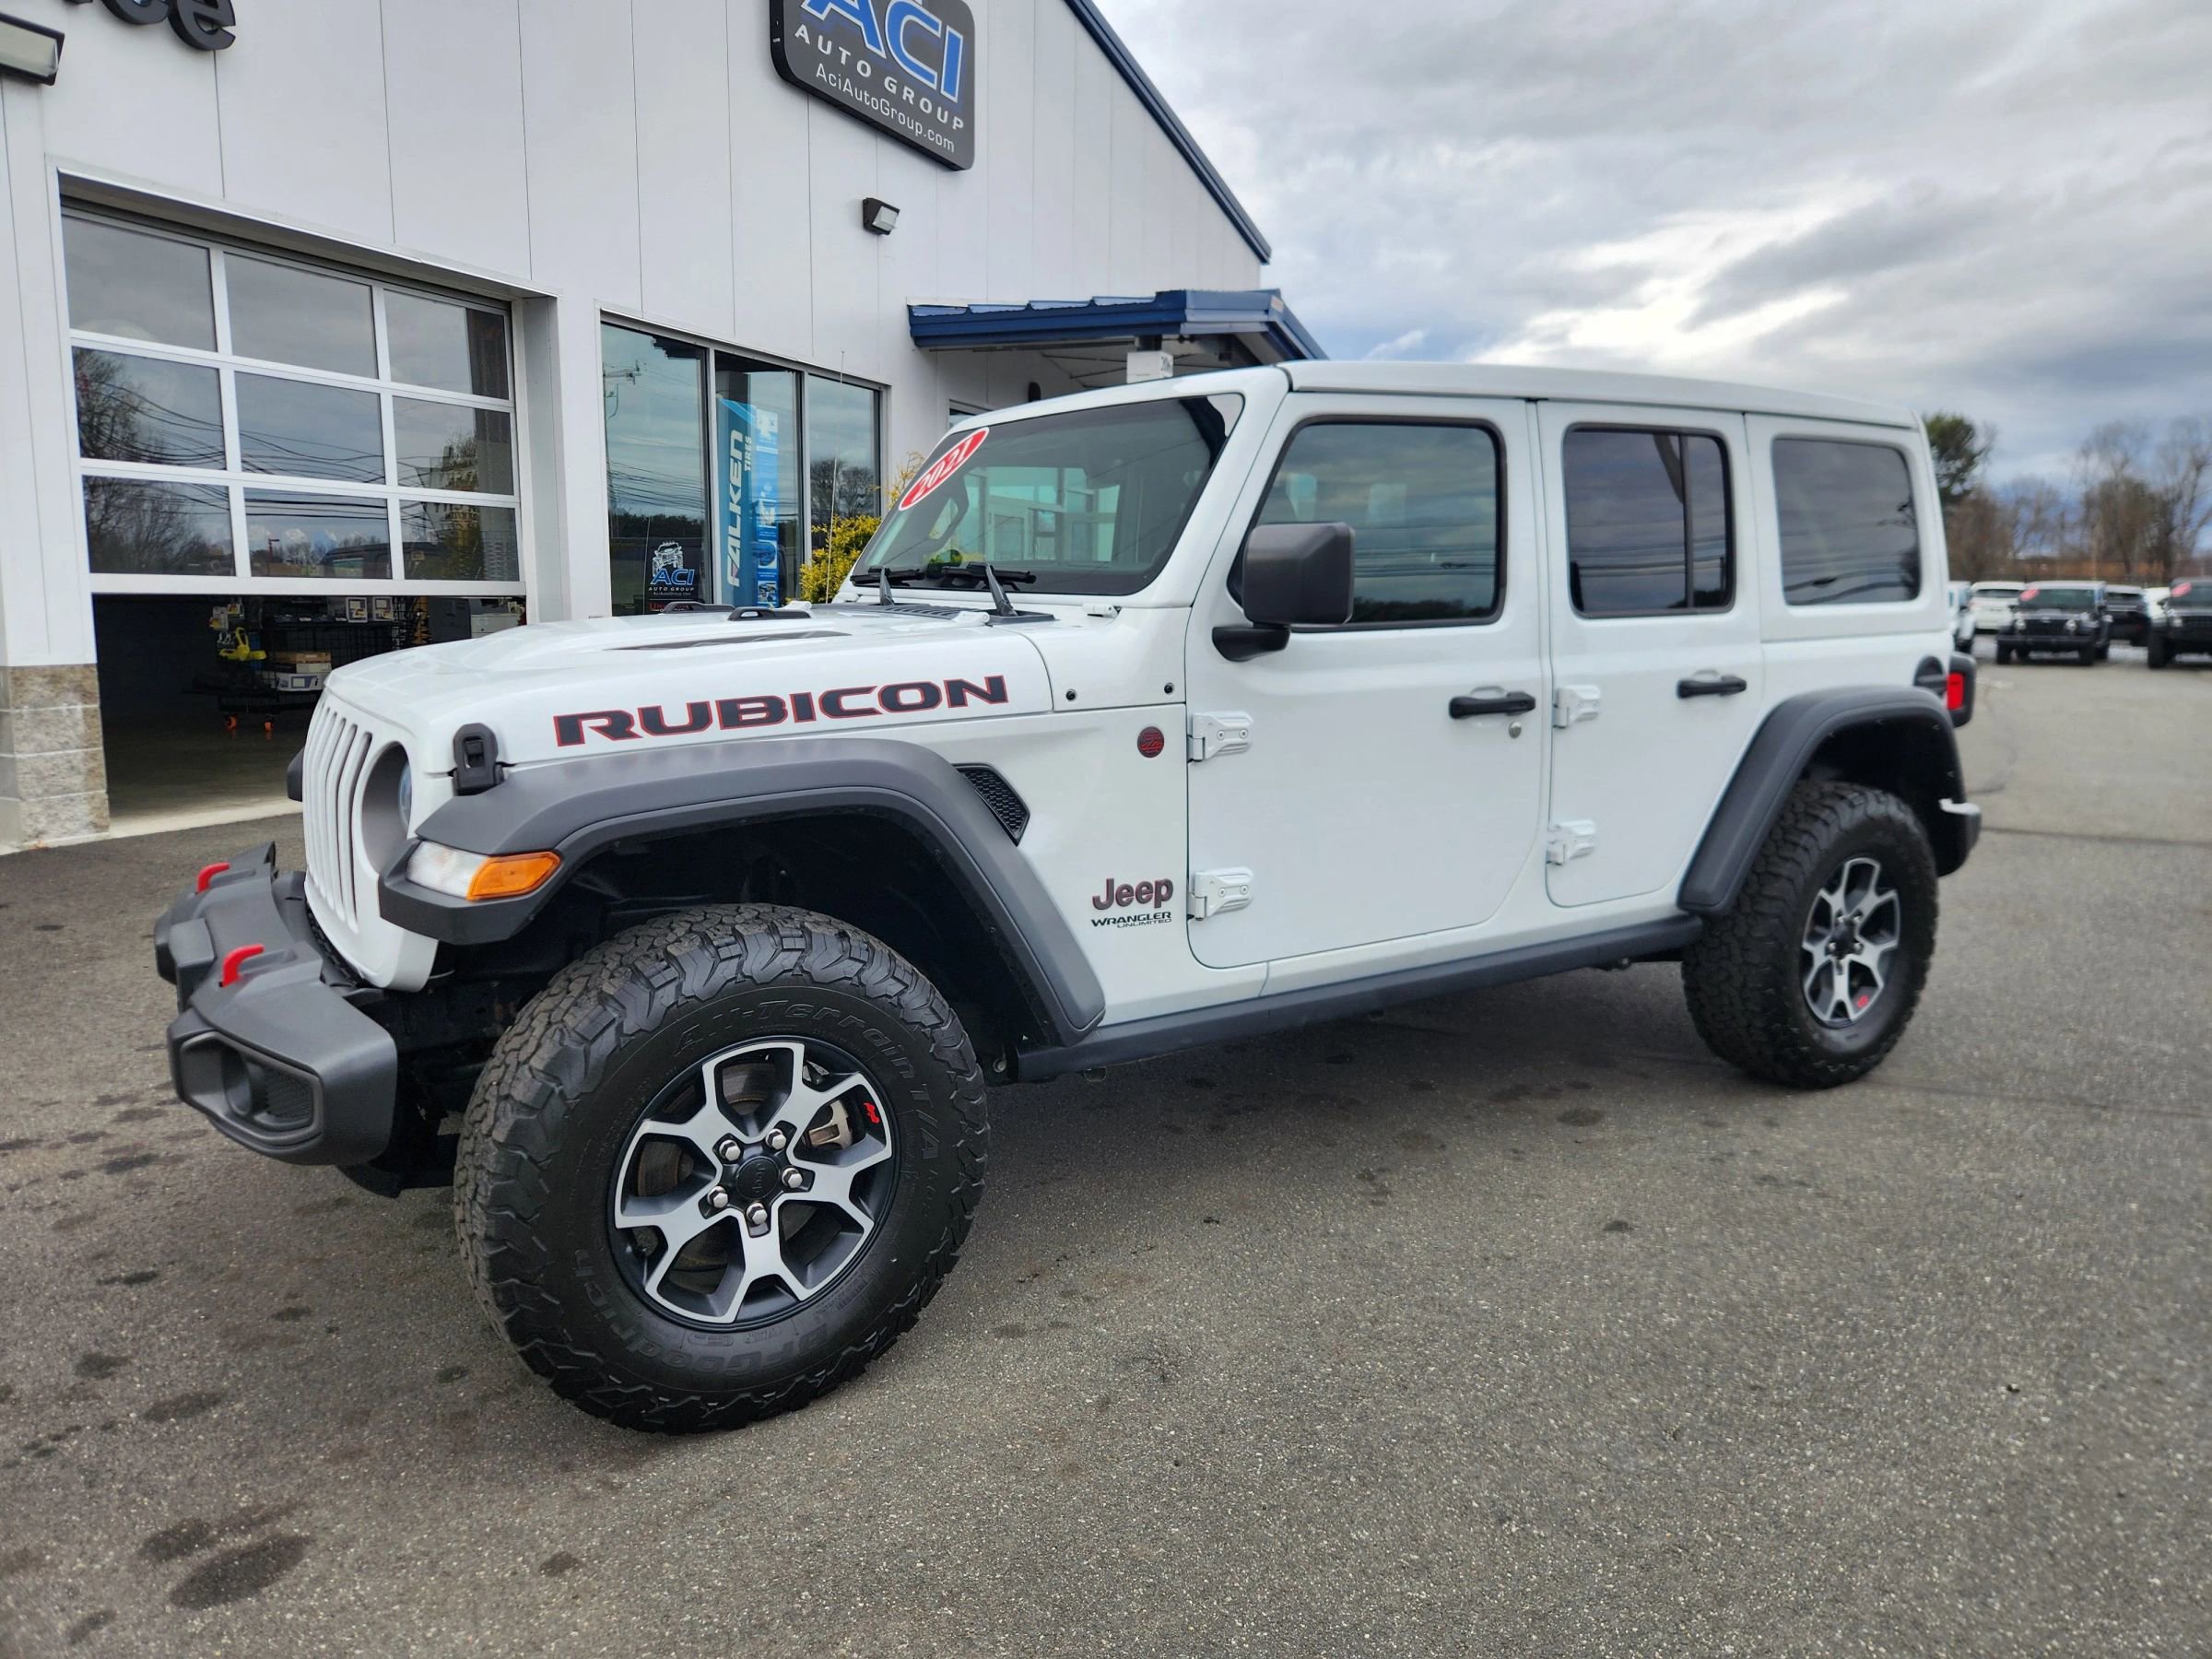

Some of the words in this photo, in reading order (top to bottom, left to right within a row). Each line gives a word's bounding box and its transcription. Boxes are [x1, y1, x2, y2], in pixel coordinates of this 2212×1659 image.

[794, 24, 872, 77] AUTO
[884, 76, 964, 130] GROUP
[816, 63, 955, 153] AciAutoGroup.com
[744, 435, 753, 472] TIRES
[911, 436, 974, 503] 2021
[650, 568, 695, 586] ACI
[553, 675, 1009, 747] RUBICON
[1091, 877, 1174, 910] Jeep
[1091, 912, 1171, 927] WRANGLER
[1116, 918, 1172, 929] UNLIMITED
